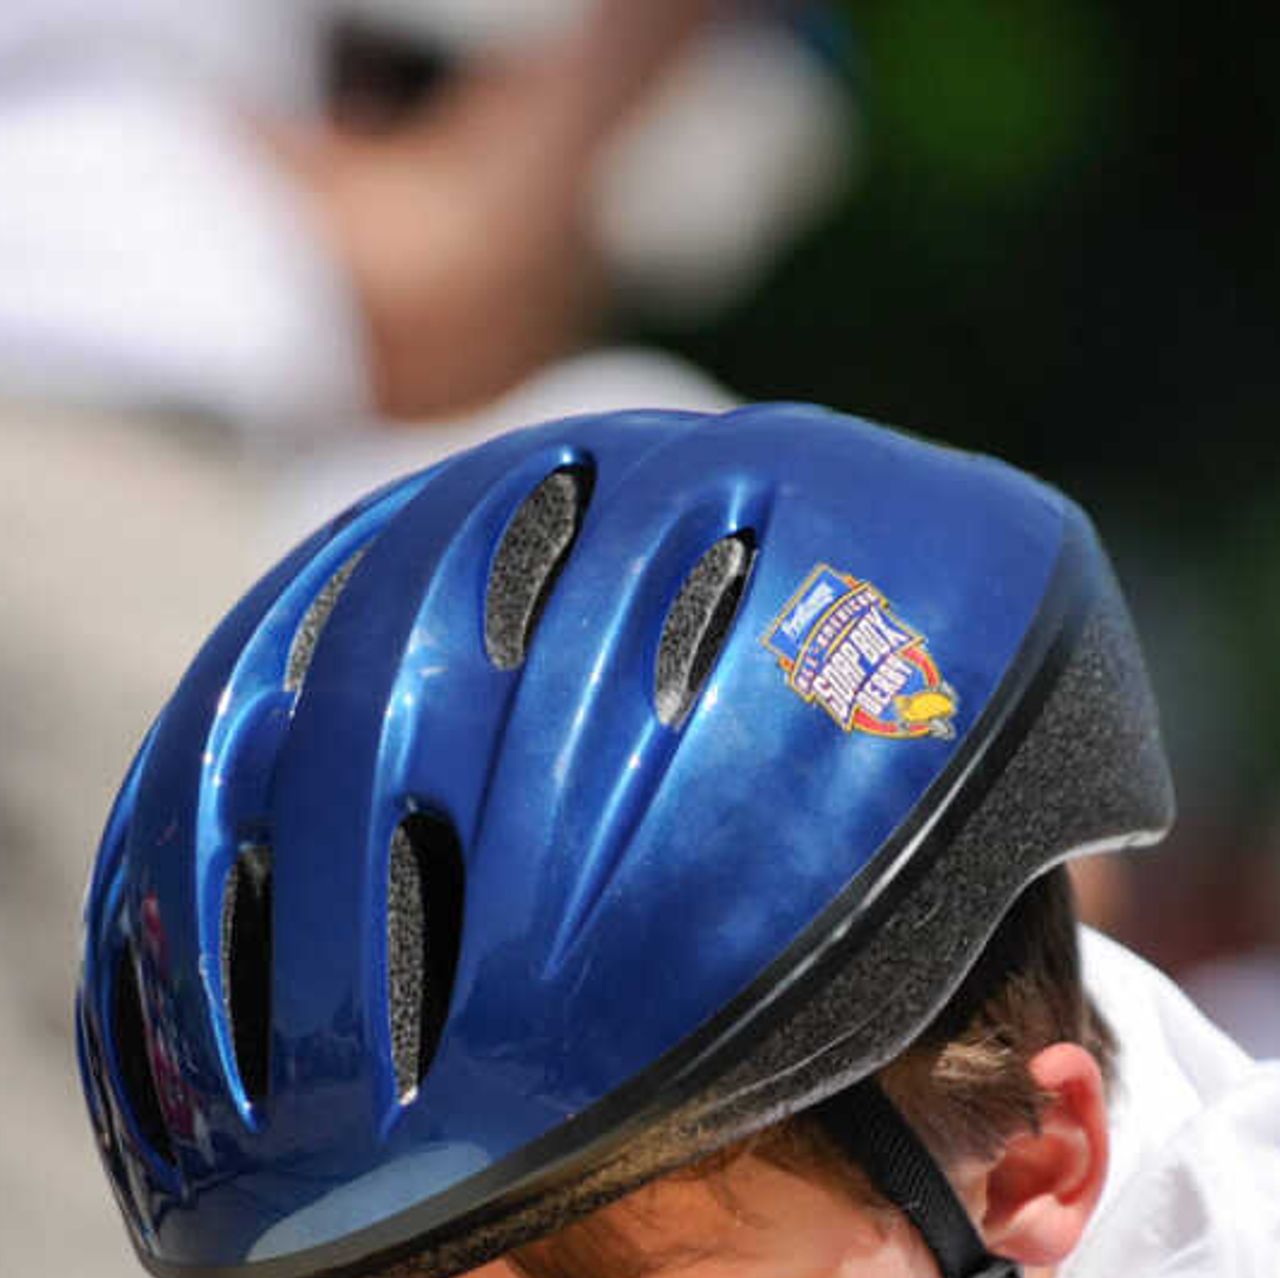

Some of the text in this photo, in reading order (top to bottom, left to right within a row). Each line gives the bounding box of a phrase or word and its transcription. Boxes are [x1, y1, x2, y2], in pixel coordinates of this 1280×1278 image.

[813, 606, 913, 718] SOAP BOX
[855, 655, 913, 716] DERBY
